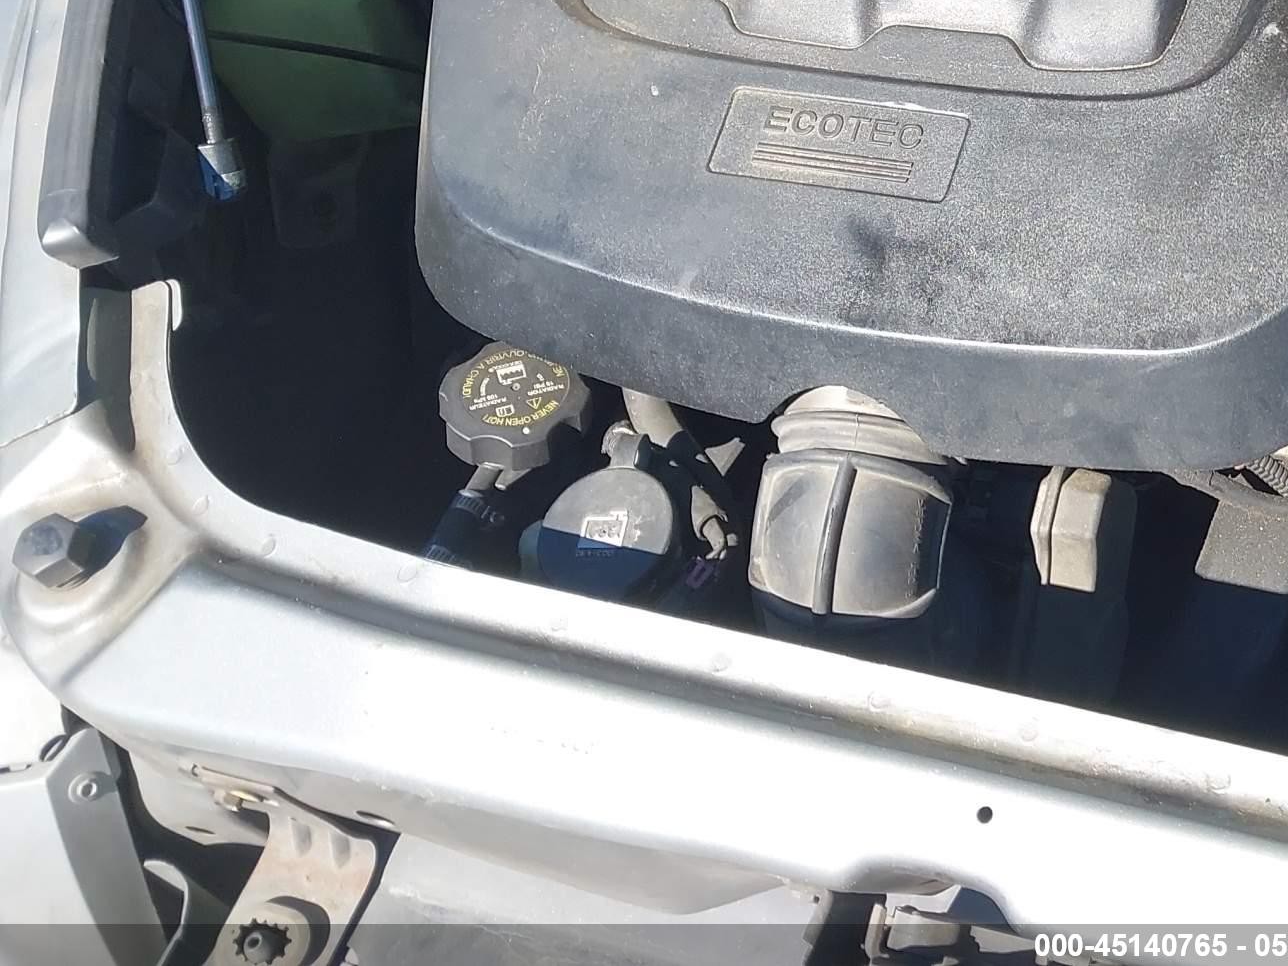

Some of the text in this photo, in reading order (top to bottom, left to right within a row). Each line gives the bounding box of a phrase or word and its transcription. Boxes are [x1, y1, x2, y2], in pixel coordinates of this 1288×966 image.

[763, 105, 925, 150] ECOTEC
[485, 349, 525, 365] OUVRIR
[462, 369, 480, 399] CHAUD!
[527, 384, 565, 396] RADIATOR
[469, 396, 507, 411] RADIATEUR
[482, 400, 560, 426] NEVER OPEN HOT!
